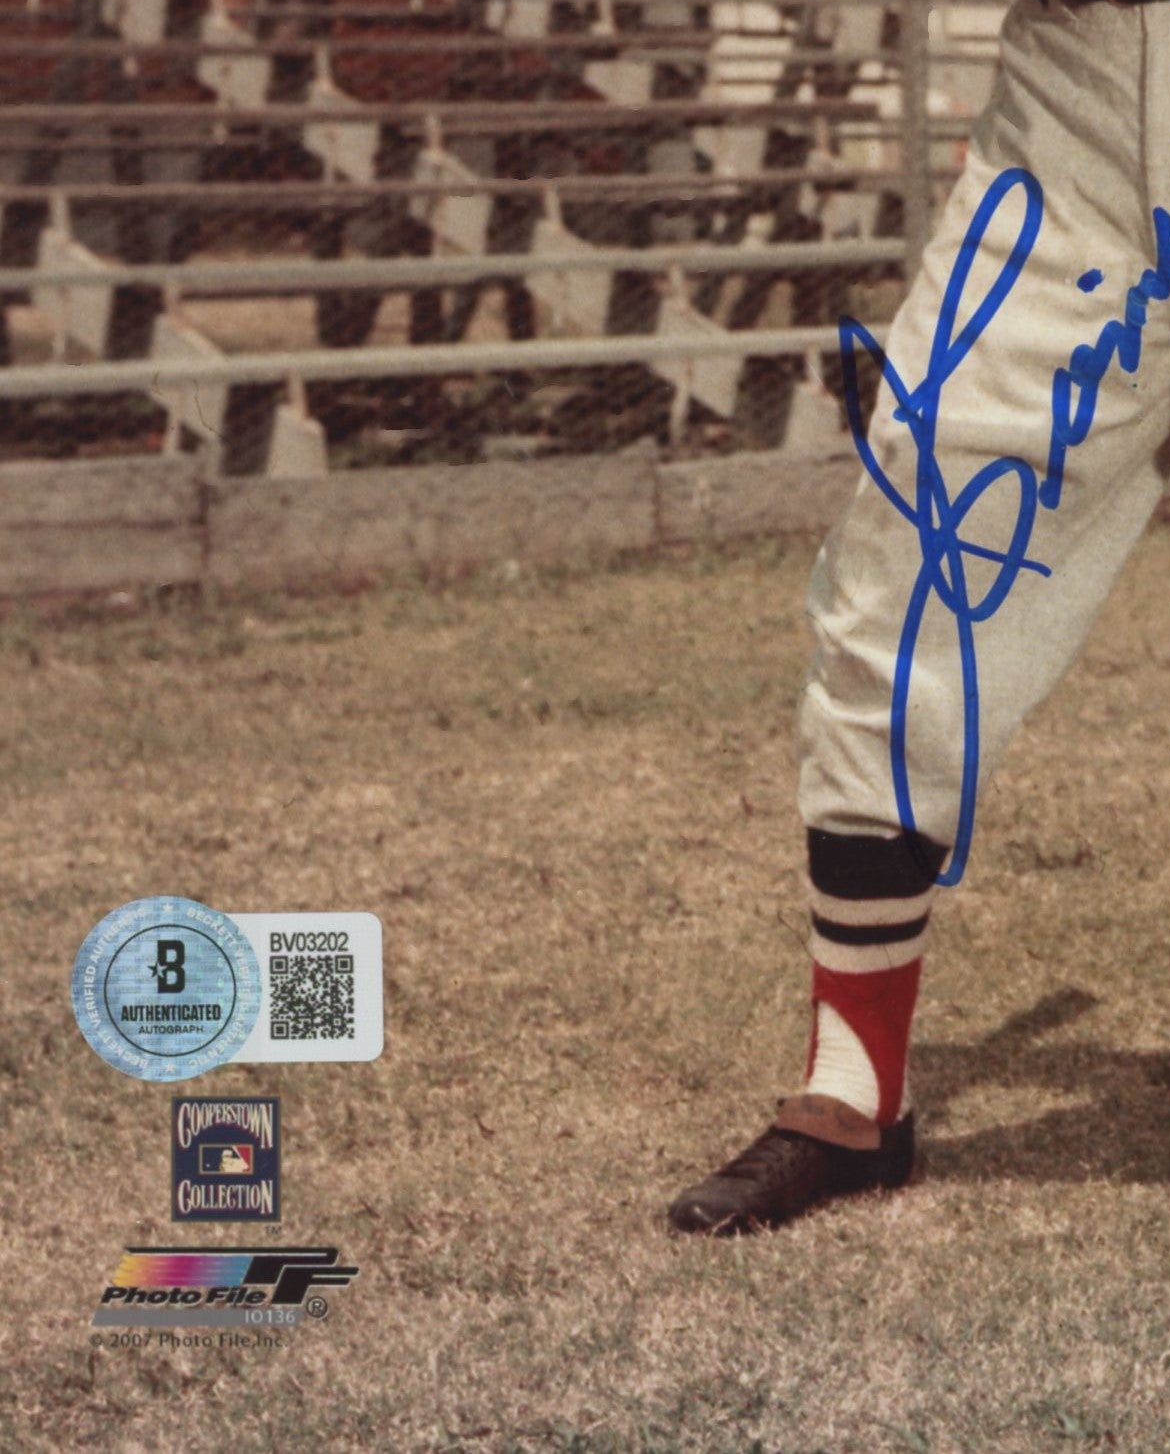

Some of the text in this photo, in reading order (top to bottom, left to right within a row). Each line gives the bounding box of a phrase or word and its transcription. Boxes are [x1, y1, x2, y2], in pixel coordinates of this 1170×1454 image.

[269, 932, 349, 952] BV03202
[84, 965, 100, 1027] VERIFIED
[121, 1004, 222, 1022] AUTHENTICATED
[138, 1025, 204, 1035] AUTOGRAPH
